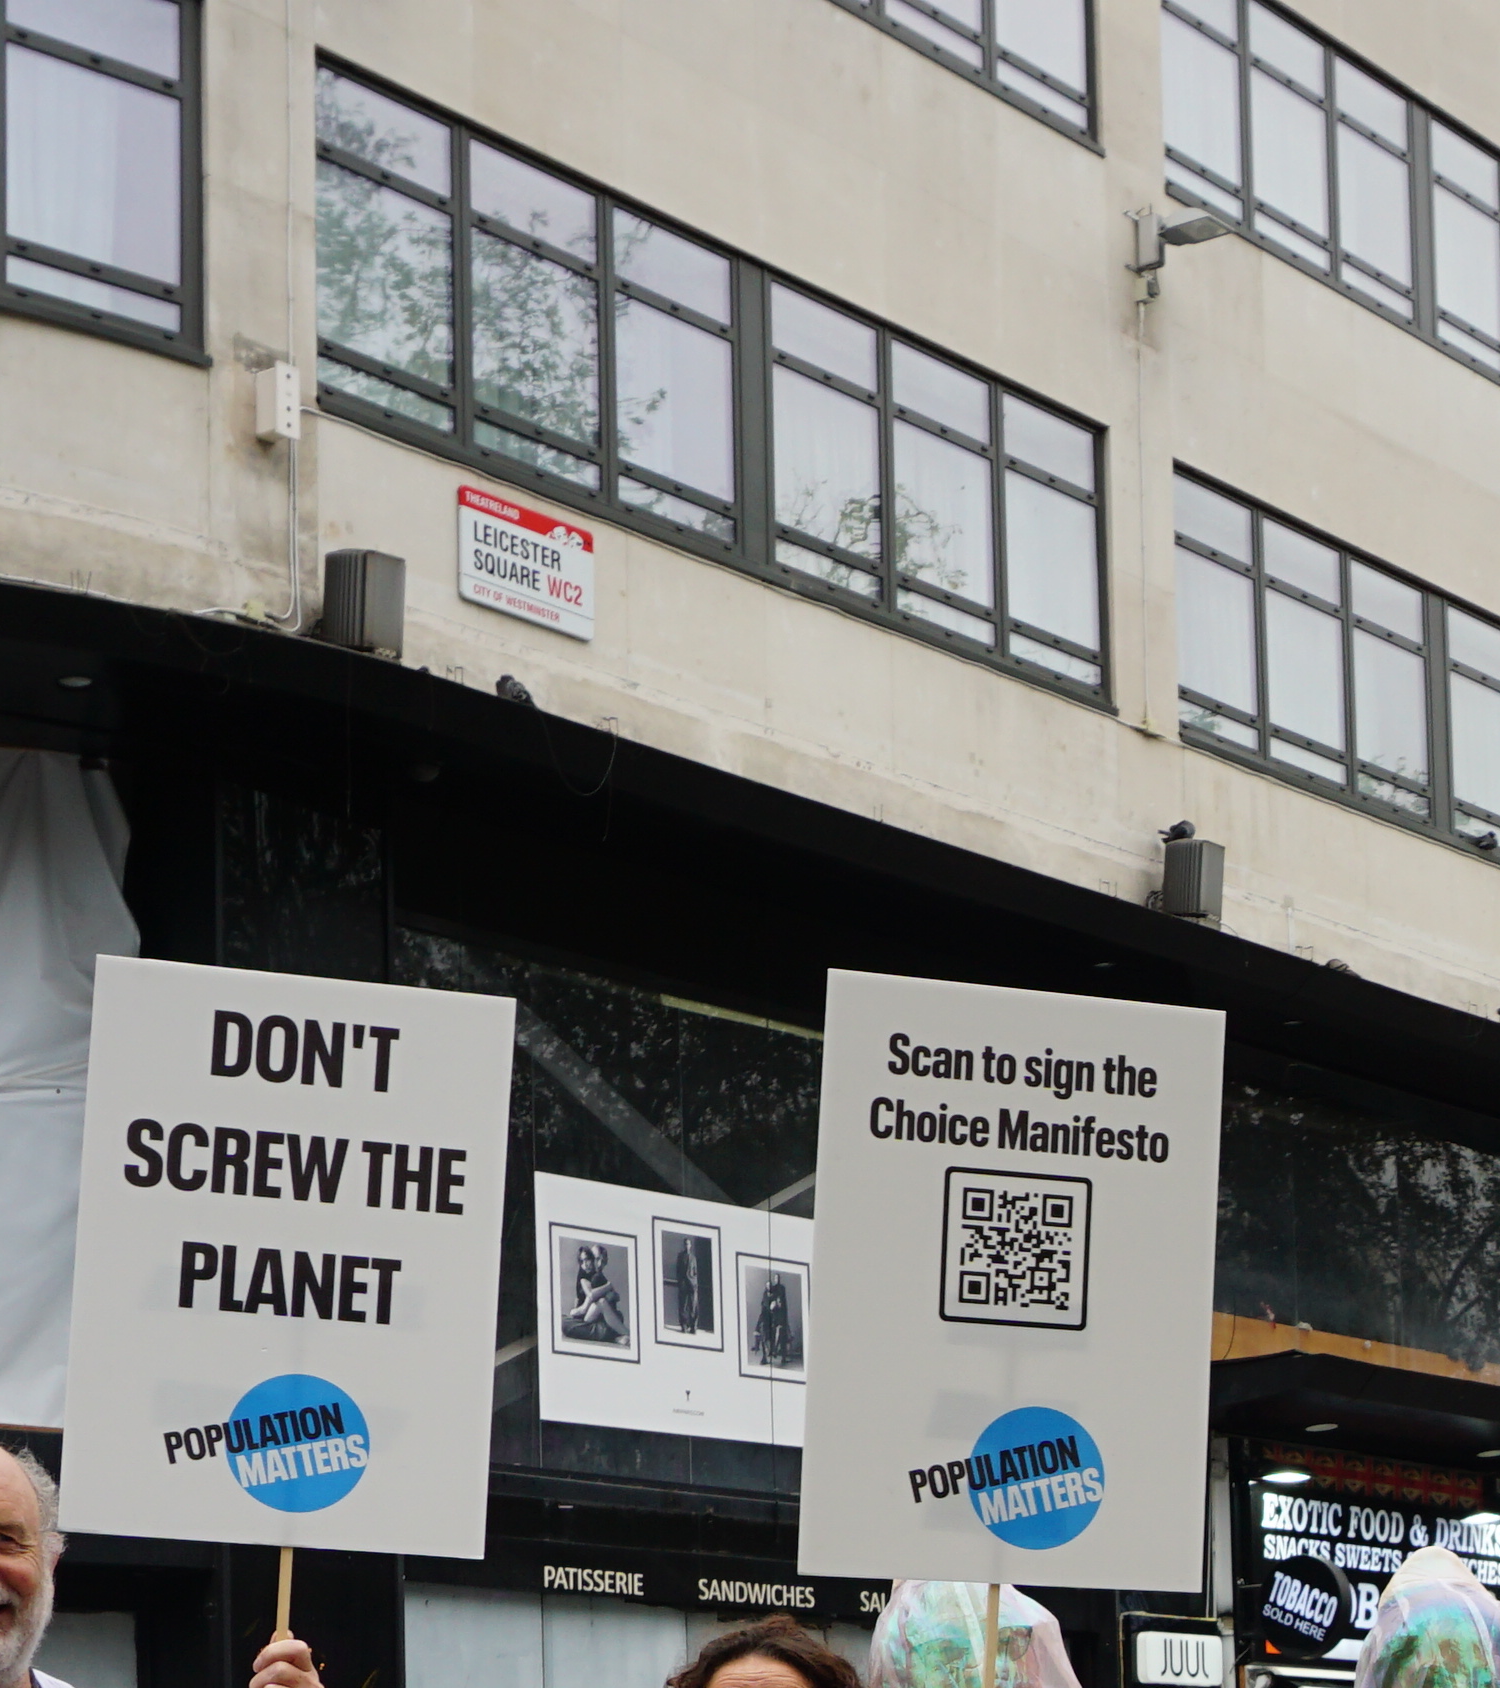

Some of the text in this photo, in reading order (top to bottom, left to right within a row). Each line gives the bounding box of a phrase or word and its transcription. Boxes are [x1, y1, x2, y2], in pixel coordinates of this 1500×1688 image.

[464, 490, 521, 520] THEATRELAND
[474, 520, 561, 572] LEICESTER
[473, 548, 583, 607] SQUARE WC2
[473, 583, 560, 623] CITY OF WESTMINSTER
[210, 1010, 400, 1093] DON'T
[888, 1032, 1157, 1100] Scan to sign the
[870, 1096, 1169, 1163] Choice Manifesto
[124, 1118, 467, 1216] SCREW THE
[178, 1241, 402, 1325] PLANET
[163, 1402, 345, 1465] POPULATION
[234, 1434, 369, 1489] MATTERS
[908, 1435, 1081, 1503] POPULATION
[978, 1467, 1103, 1526] MATTERS
[1261, 1492, 1342, 1536] EXOTIC
[1347, 1505, 1404, 1543] FOOD
[1409, 1514, 1429, 1547] &
[1263, 1534, 1331, 1561] SNACKS
[1334, 1542, 1402, 1574] SWEETS
[543, 1566, 886, 1613] PATISSERIE SANDWICHES SAL
[1268, 1571, 1338, 1628] TOBACCO
[1262, 1603, 1326, 1642] SOLD HERE
[1161, 1638, 1209, 1679] JUUL
